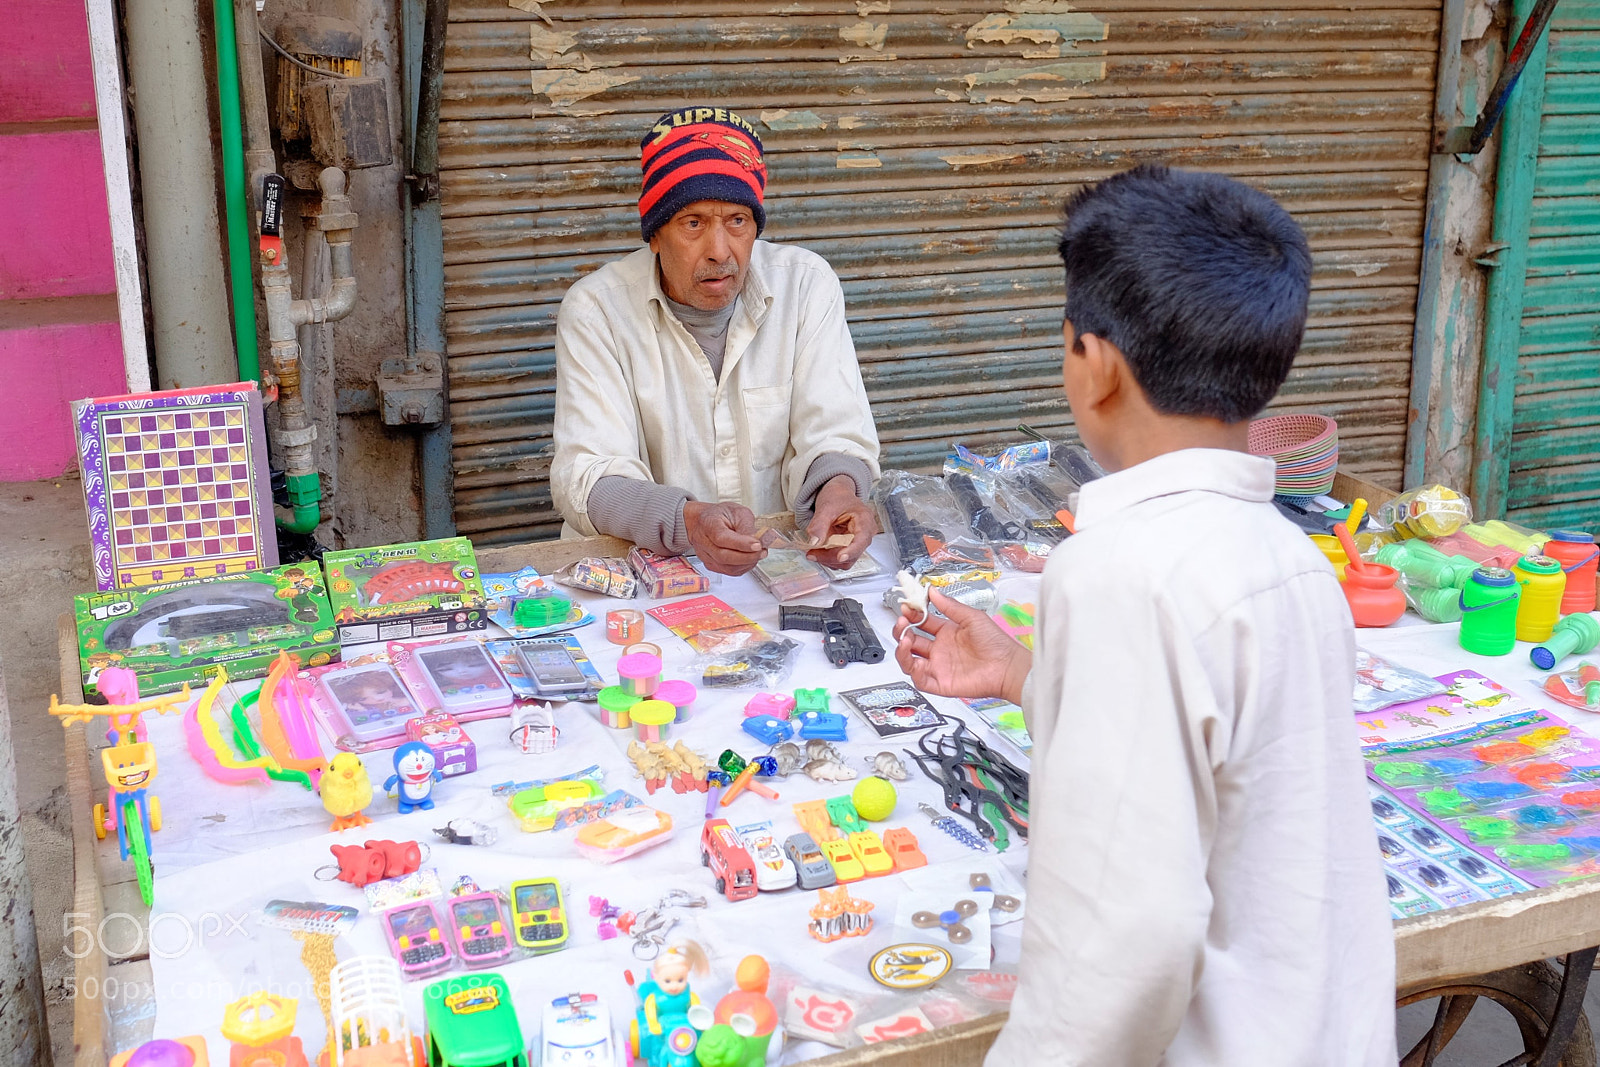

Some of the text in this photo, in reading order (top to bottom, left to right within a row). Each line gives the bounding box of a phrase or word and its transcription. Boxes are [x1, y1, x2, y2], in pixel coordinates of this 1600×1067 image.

[90, 592, 129, 609] BEN
[91, 601, 132, 620] 10
[650, 606, 668, 615] 72
[278, 907, 343, 922] SHAKTI
